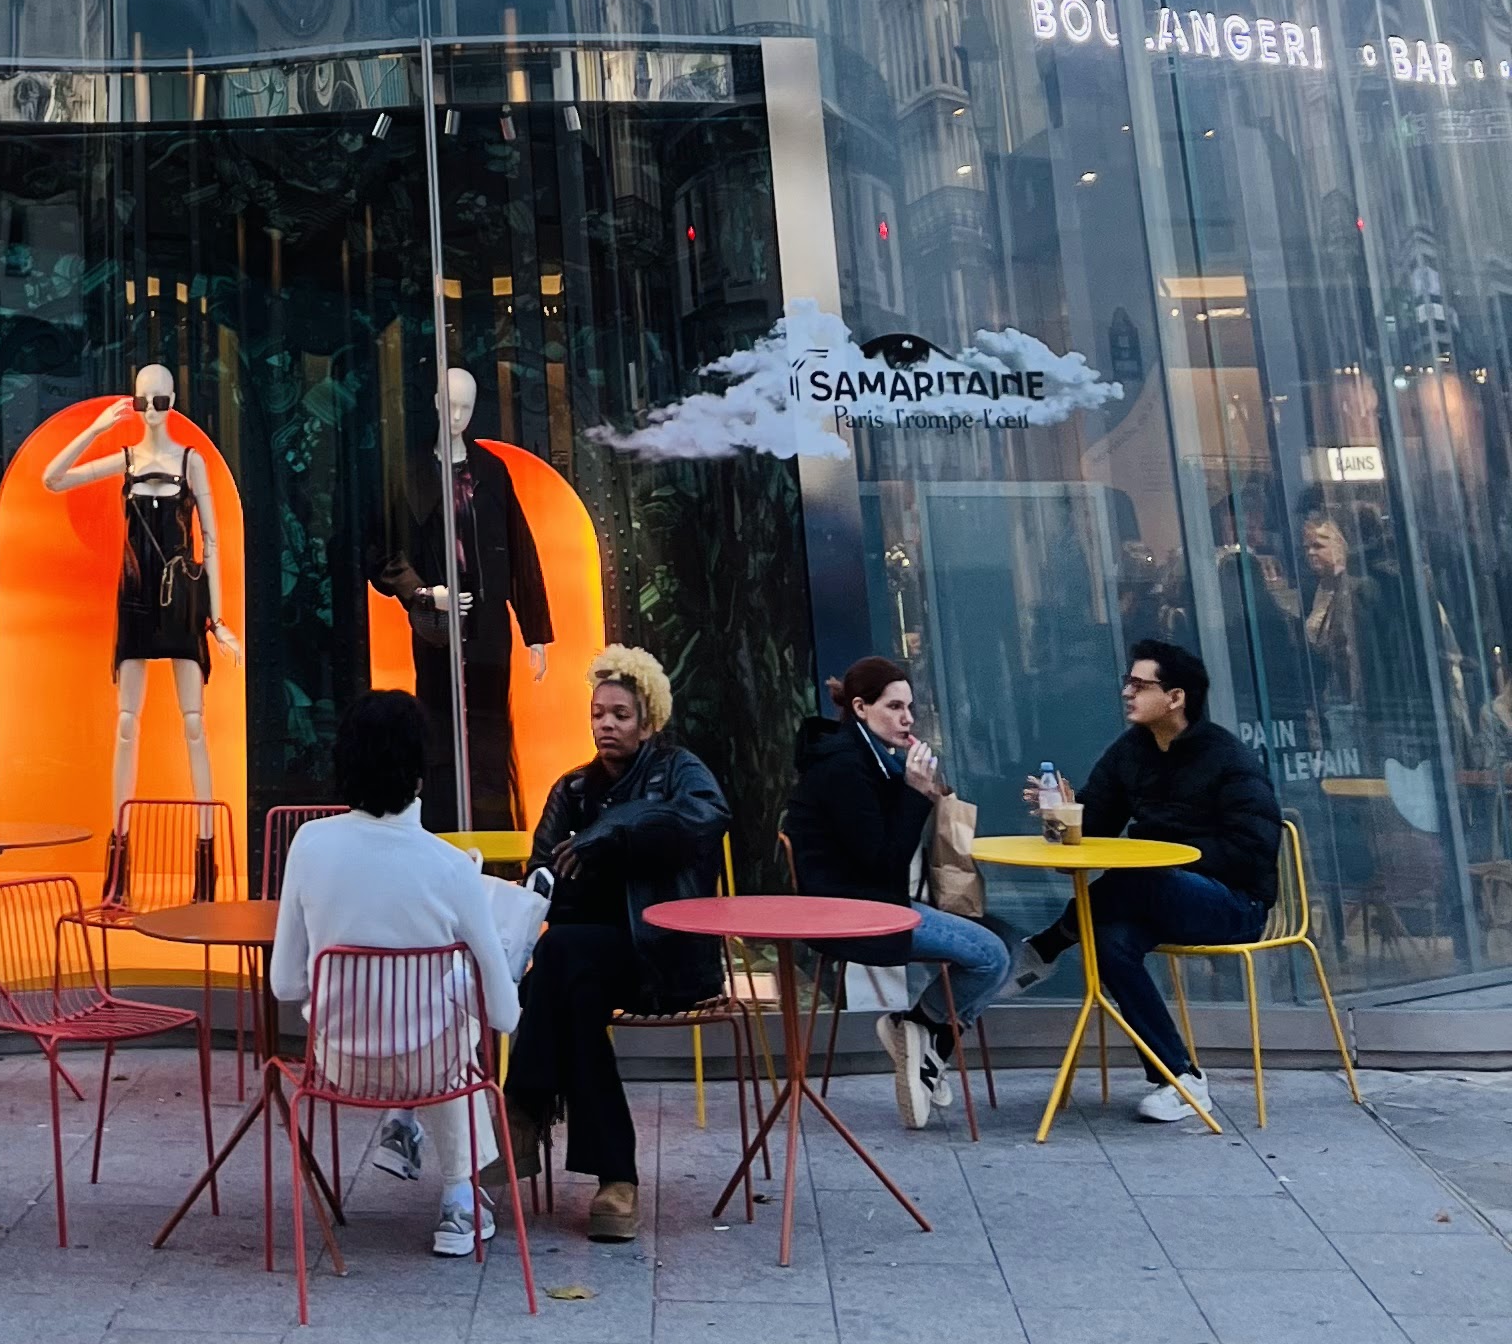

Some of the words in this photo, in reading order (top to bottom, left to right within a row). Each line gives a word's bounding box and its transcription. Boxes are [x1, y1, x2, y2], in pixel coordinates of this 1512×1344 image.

[1388, 34, 1457, 85] BAR
[809, 370, 1045, 402] SAMARITAINE
[834, 404, 884, 433] Paris
[1240, 719, 1297, 750] PAIN
[1283, 748, 1361, 782] LEVAIN
